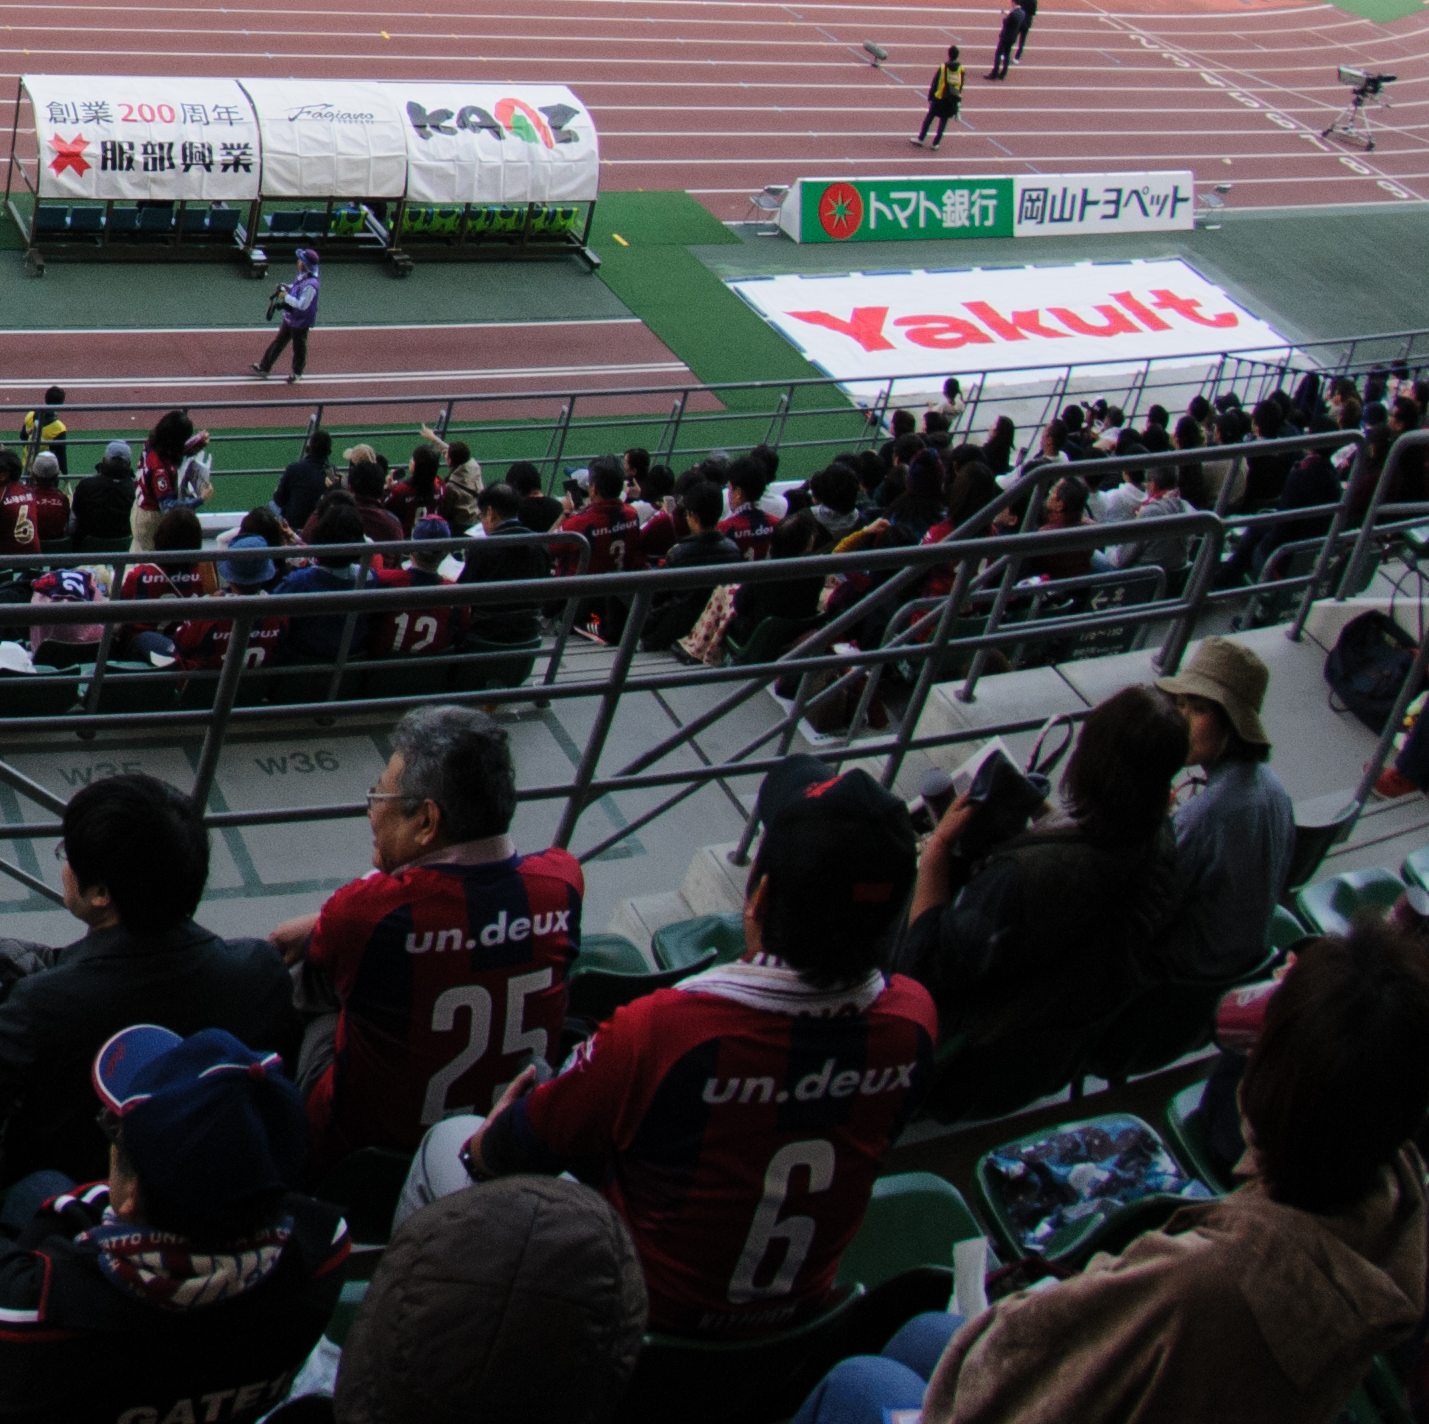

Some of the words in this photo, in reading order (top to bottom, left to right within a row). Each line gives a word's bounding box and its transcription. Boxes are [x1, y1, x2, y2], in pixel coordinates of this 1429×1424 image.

[46, 100, 244, 127] 創業200周年
[287, 103, 375, 124] Fagiano
[99, 138, 254, 174] 服部興業
[869, 188, 999, 230] トマト銀行
[1016, 184, 1191, 227] 岡山トヨペット
[782, 288, 1240, 353] Yakult
[13, 504, 36, 545] 6
[391, 611, 438, 653] 12
[253, 749, 341, 776] W36
[403, 908, 572, 957] un.deux
[419, 967, 554, 1127] 25
[700, 1057, 917, 1108] un.deux
[726, 1138, 837, 1305] 6
